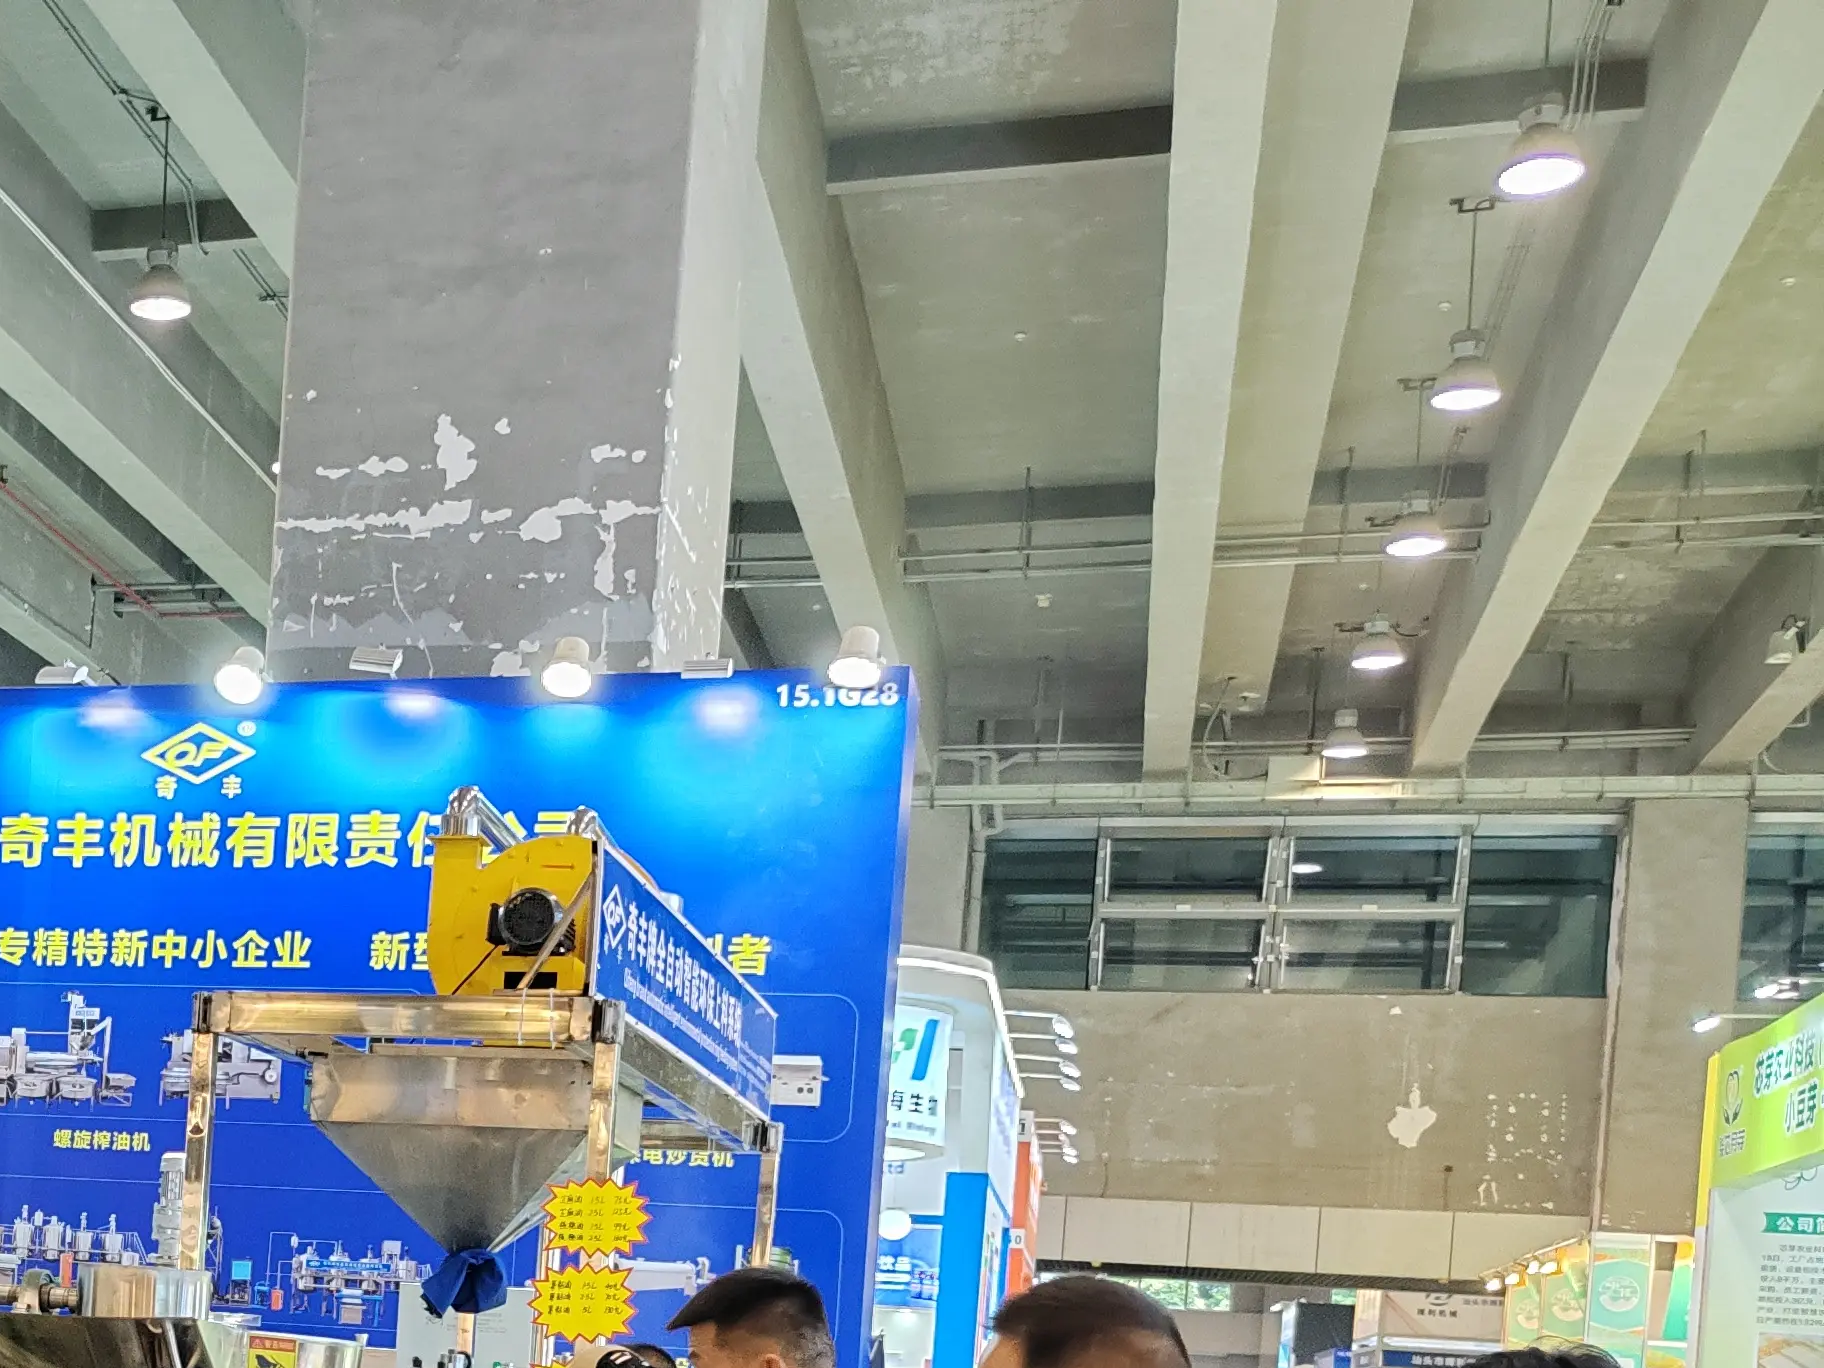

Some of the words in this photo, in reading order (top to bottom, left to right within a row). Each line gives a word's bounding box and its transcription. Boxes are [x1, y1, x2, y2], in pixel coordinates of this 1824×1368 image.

[53, 1129, 151, 1153] 螺旋榨油机
